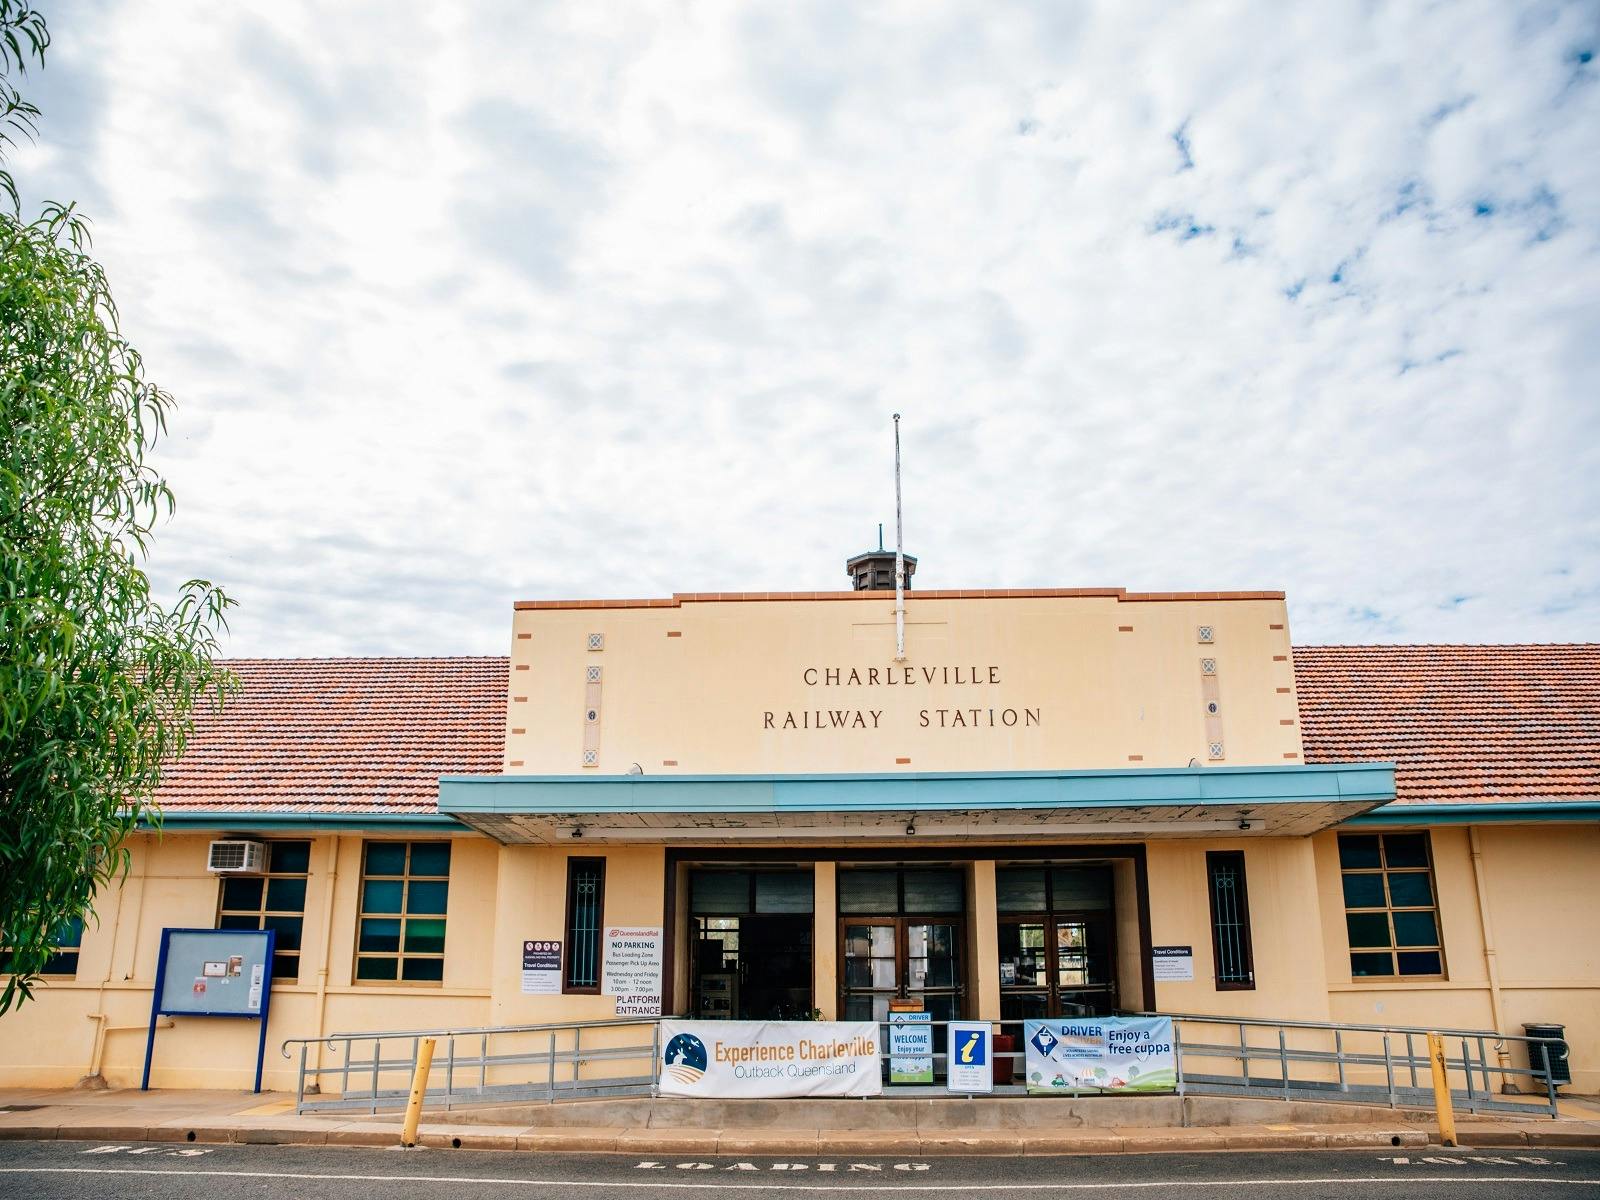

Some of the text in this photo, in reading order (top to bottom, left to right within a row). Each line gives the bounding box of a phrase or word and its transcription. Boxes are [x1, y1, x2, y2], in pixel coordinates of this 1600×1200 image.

[803, 666, 1002, 686] CHARLEVILLE
[763, 708, 1041, 729] RAILWAY STATION
[616, 995, 660, 1004] PLATFORM
[616, 1006, 660, 1015] ENTRANCE
[1062, 1026, 1102, 1036] DRIVER
[1109, 1030, 1150, 1043] Enjoy a
[895, 1035, 927, 1044] WELCOME
[715, 1036, 875, 1067] Experience Charleville
[1109, 1043, 1170, 1055] free cuppa
[735, 1062, 856, 1079] Outback Queensland
[634, 1162, 931, 1171] LOADING
